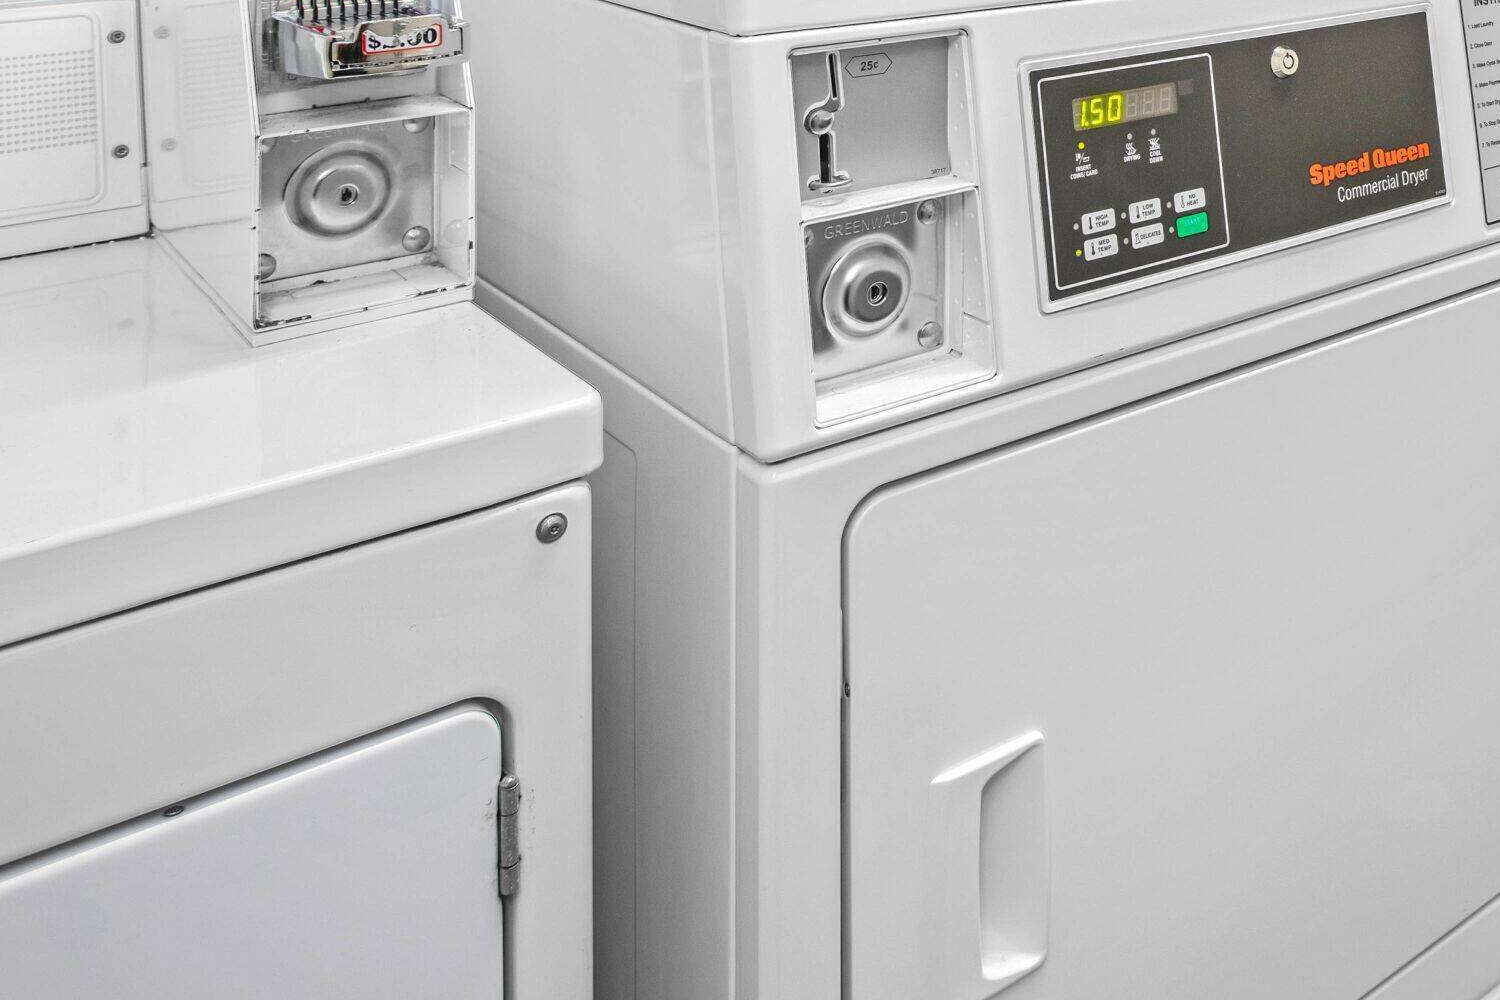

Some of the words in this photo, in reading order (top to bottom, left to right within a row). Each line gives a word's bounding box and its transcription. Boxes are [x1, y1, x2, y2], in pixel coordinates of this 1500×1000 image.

[368, 28, 437, 50] $.00
[1309, 152, 1370, 186] Speed
[1372, 142, 1430, 168] Queen
[1337, 174, 1399, 203] Commercial
[1402, 168, 1429, 187] Dryer
[824, 210, 909, 240] GREENWALD
[1140, 230, 1161, 241] DELICATES
[1097, 245, 1112, 253] TEMP
